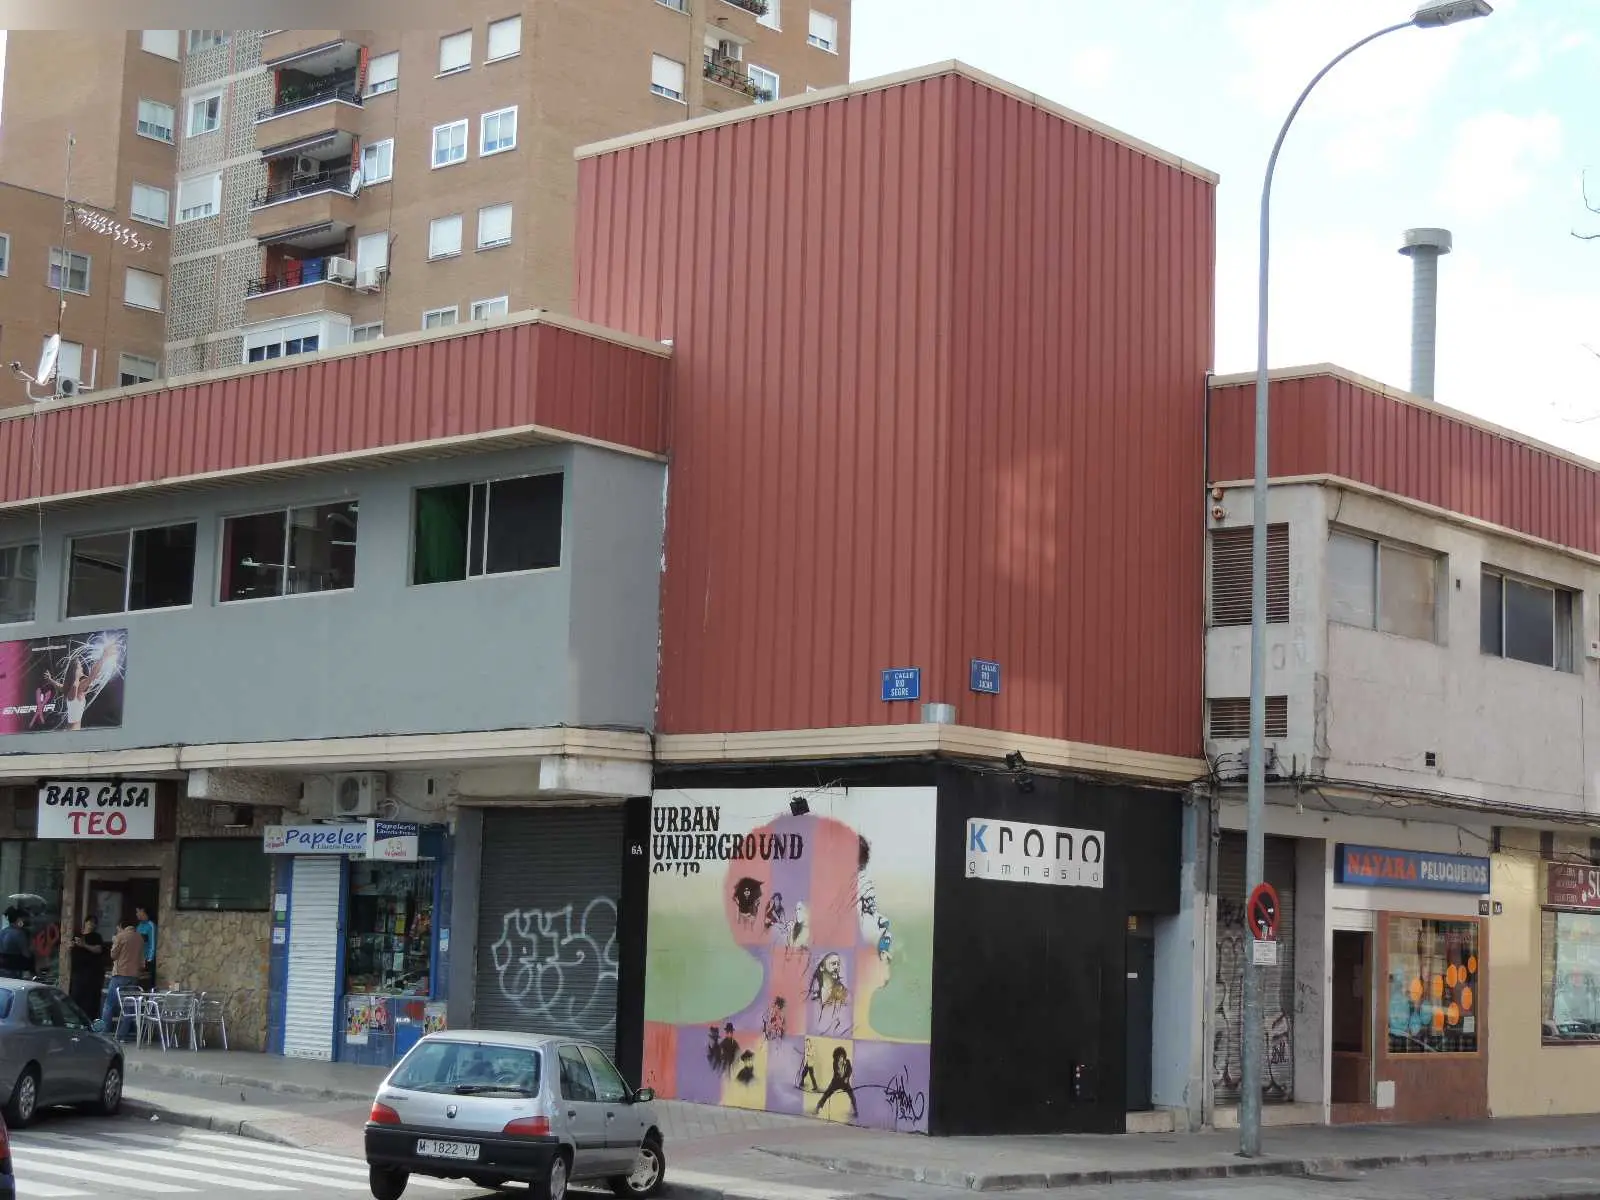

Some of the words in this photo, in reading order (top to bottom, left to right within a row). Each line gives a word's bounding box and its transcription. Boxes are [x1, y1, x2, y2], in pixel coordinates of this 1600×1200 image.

[894, 671, 914, 680] CALLE
[890, 687, 909, 696] SEGRE
[46, 786, 90, 808] BAR
[97, 786, 149, 808] CASA
[68, 811, 127, 836] TEO
[653, 806, 721, 833] URBAN
[652, 833, 803, 861] UNDERGROUND
[969, 860, 1099, 882] gimnasio
[1347, 852, 1417, 881] NAYARA
[1421, 860, 1488, 884] PELUQUEROS
[418, 1140, 426, 1151] M
[433, 1142, 458, 1155] 1822
[465, 1145, 478, 1156] VY
